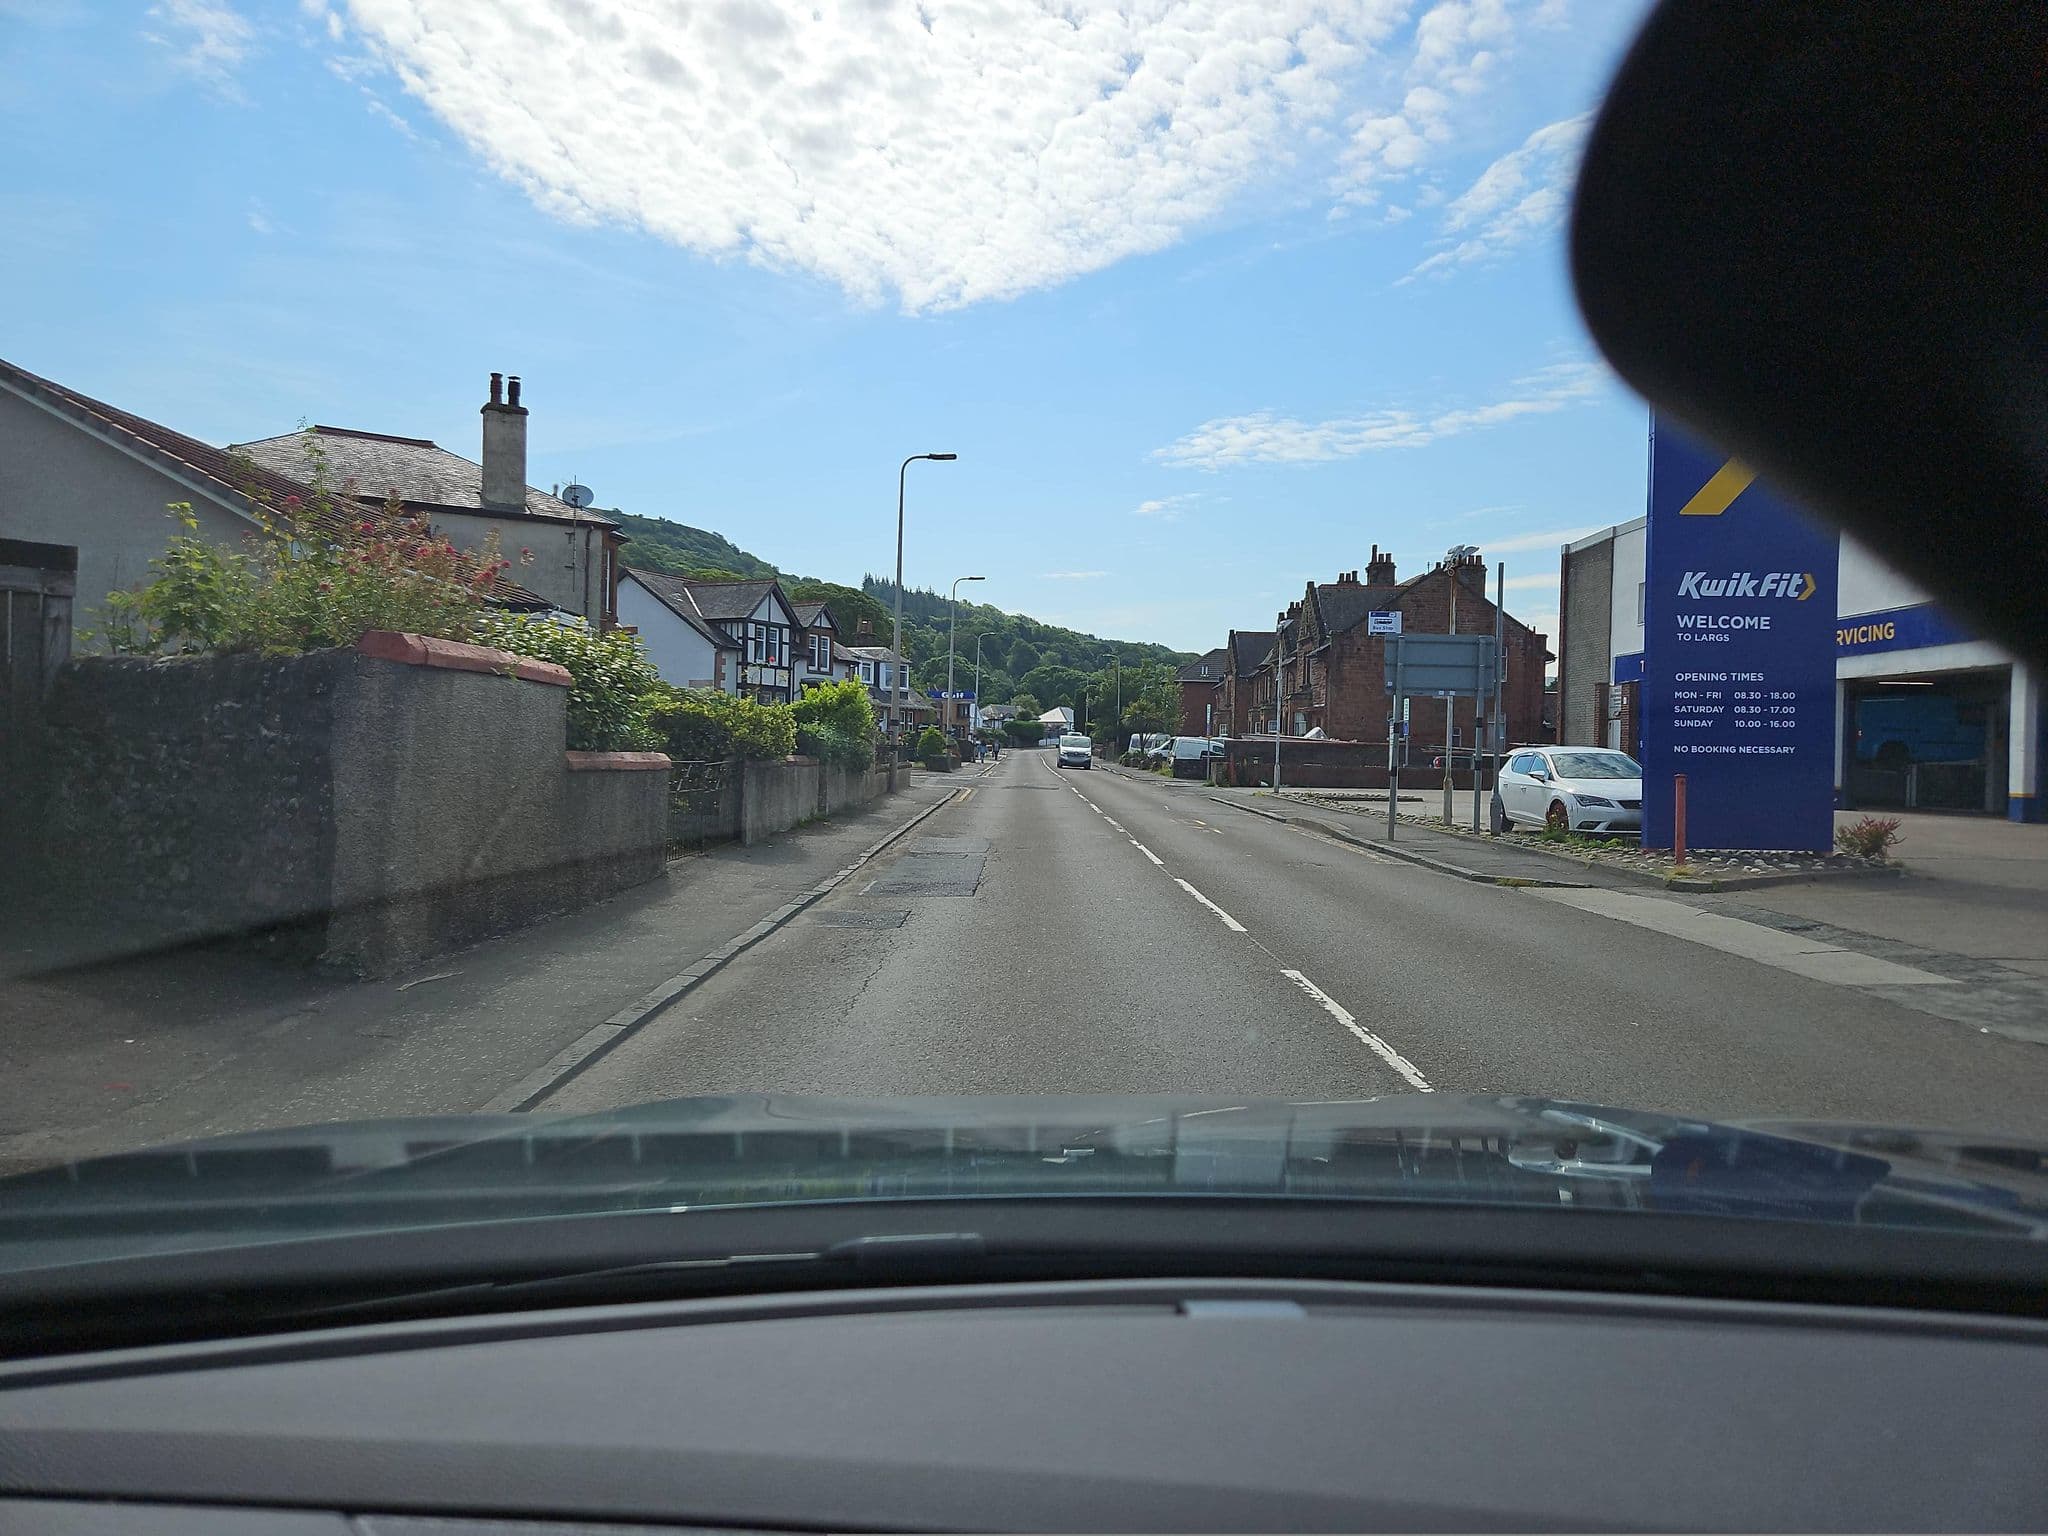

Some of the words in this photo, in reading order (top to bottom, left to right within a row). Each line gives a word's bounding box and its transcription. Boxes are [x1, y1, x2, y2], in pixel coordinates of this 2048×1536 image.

[1677, 614, 1771, 630] WELCOME
[1677, 633, 1692, 641] TO
[1694, 633, 1730, 642] LARGS
[1675, 672, 1728, 682] OPENING
[1730, 672, 1764, 682] TIMES
[1674, 691, 1698, 699] MON
[1706, 691, 1722, 699] FRI
[1734, 691, 1761, 700] 08.30
[1769, 692, 1796, 700] 18.00
[1674, 705, 1725, 714] SATURDAY
[1734, 706, 1761, 714] 08.30
[1769, 706, 1796, 714] 17.00
[1674, 719, 1714, 728] SUNDAY
[1734, 720, 1761, 728] 10.00
[1769, 720, 1796, 728] 16.00
[1674, 745, 1688, 753] NO
[1691, 745, 1737, 754] BOOKING
[1739, 746, 1796, 755] NECESSARY
